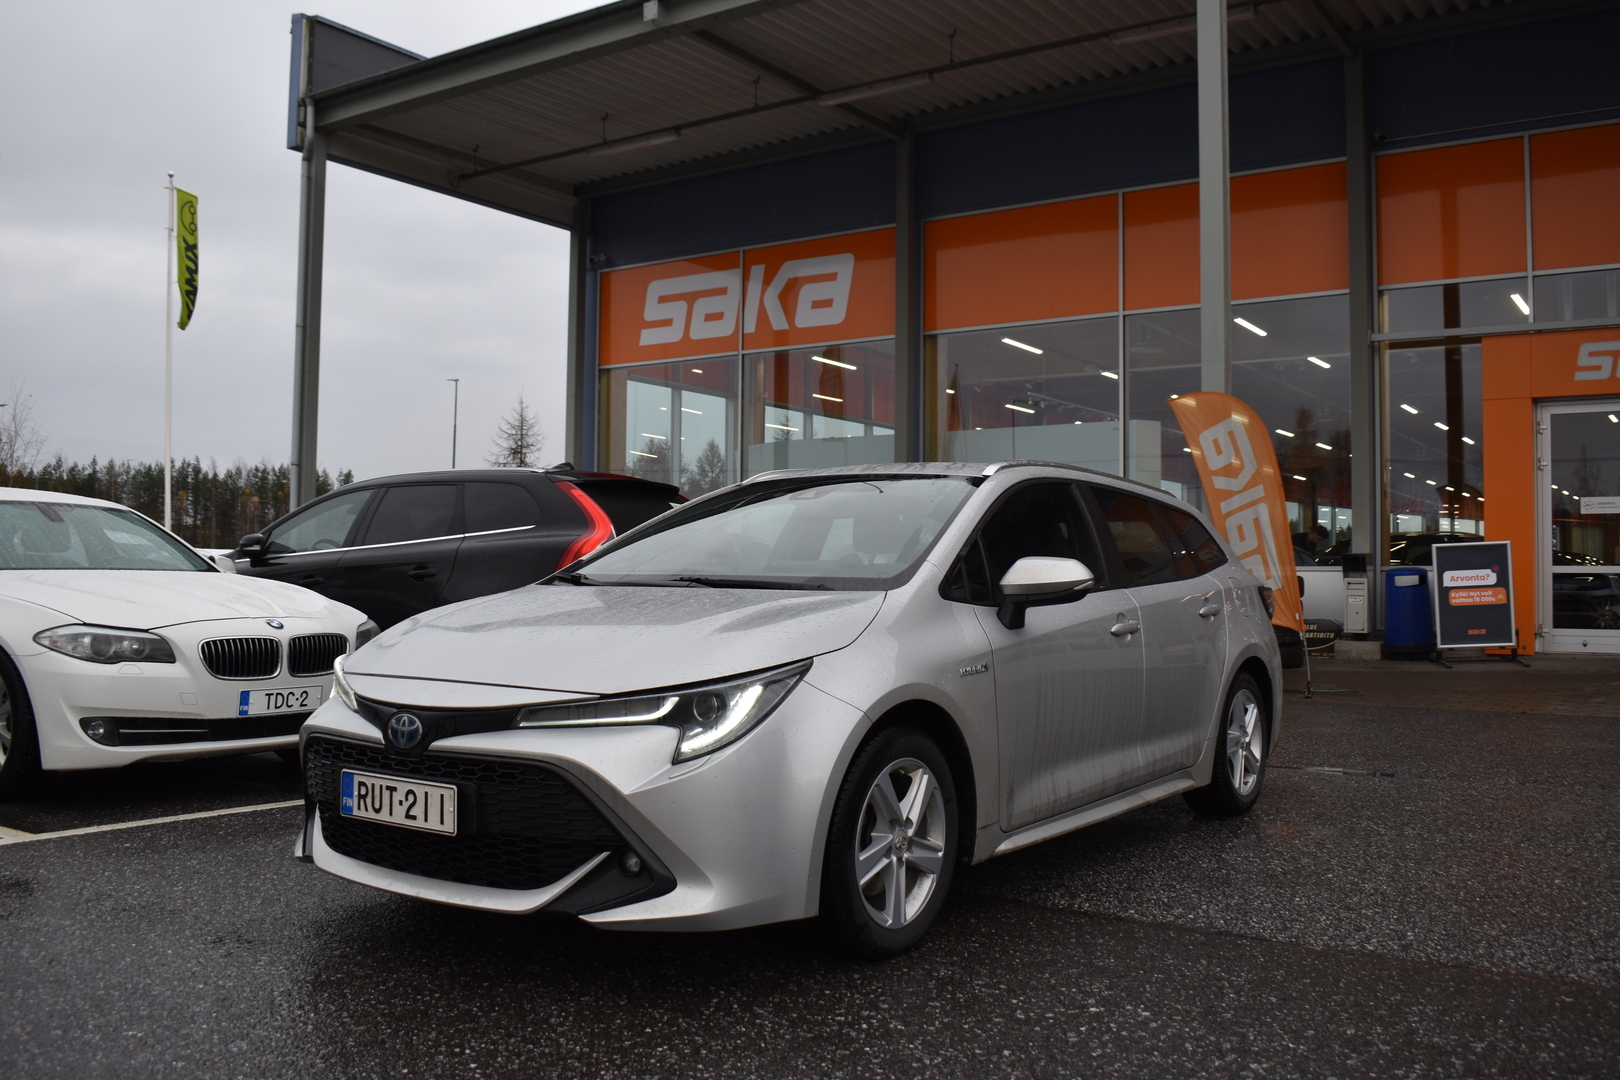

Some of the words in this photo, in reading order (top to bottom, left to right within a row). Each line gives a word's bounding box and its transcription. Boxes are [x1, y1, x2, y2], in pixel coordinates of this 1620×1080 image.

[1449, 574, 1490, 582] Arvonta?
[265, 690, 308, 710] TDC-2
[343, 797, 353, 807] FIN
[357, 780, 445, 825] RUT-211
